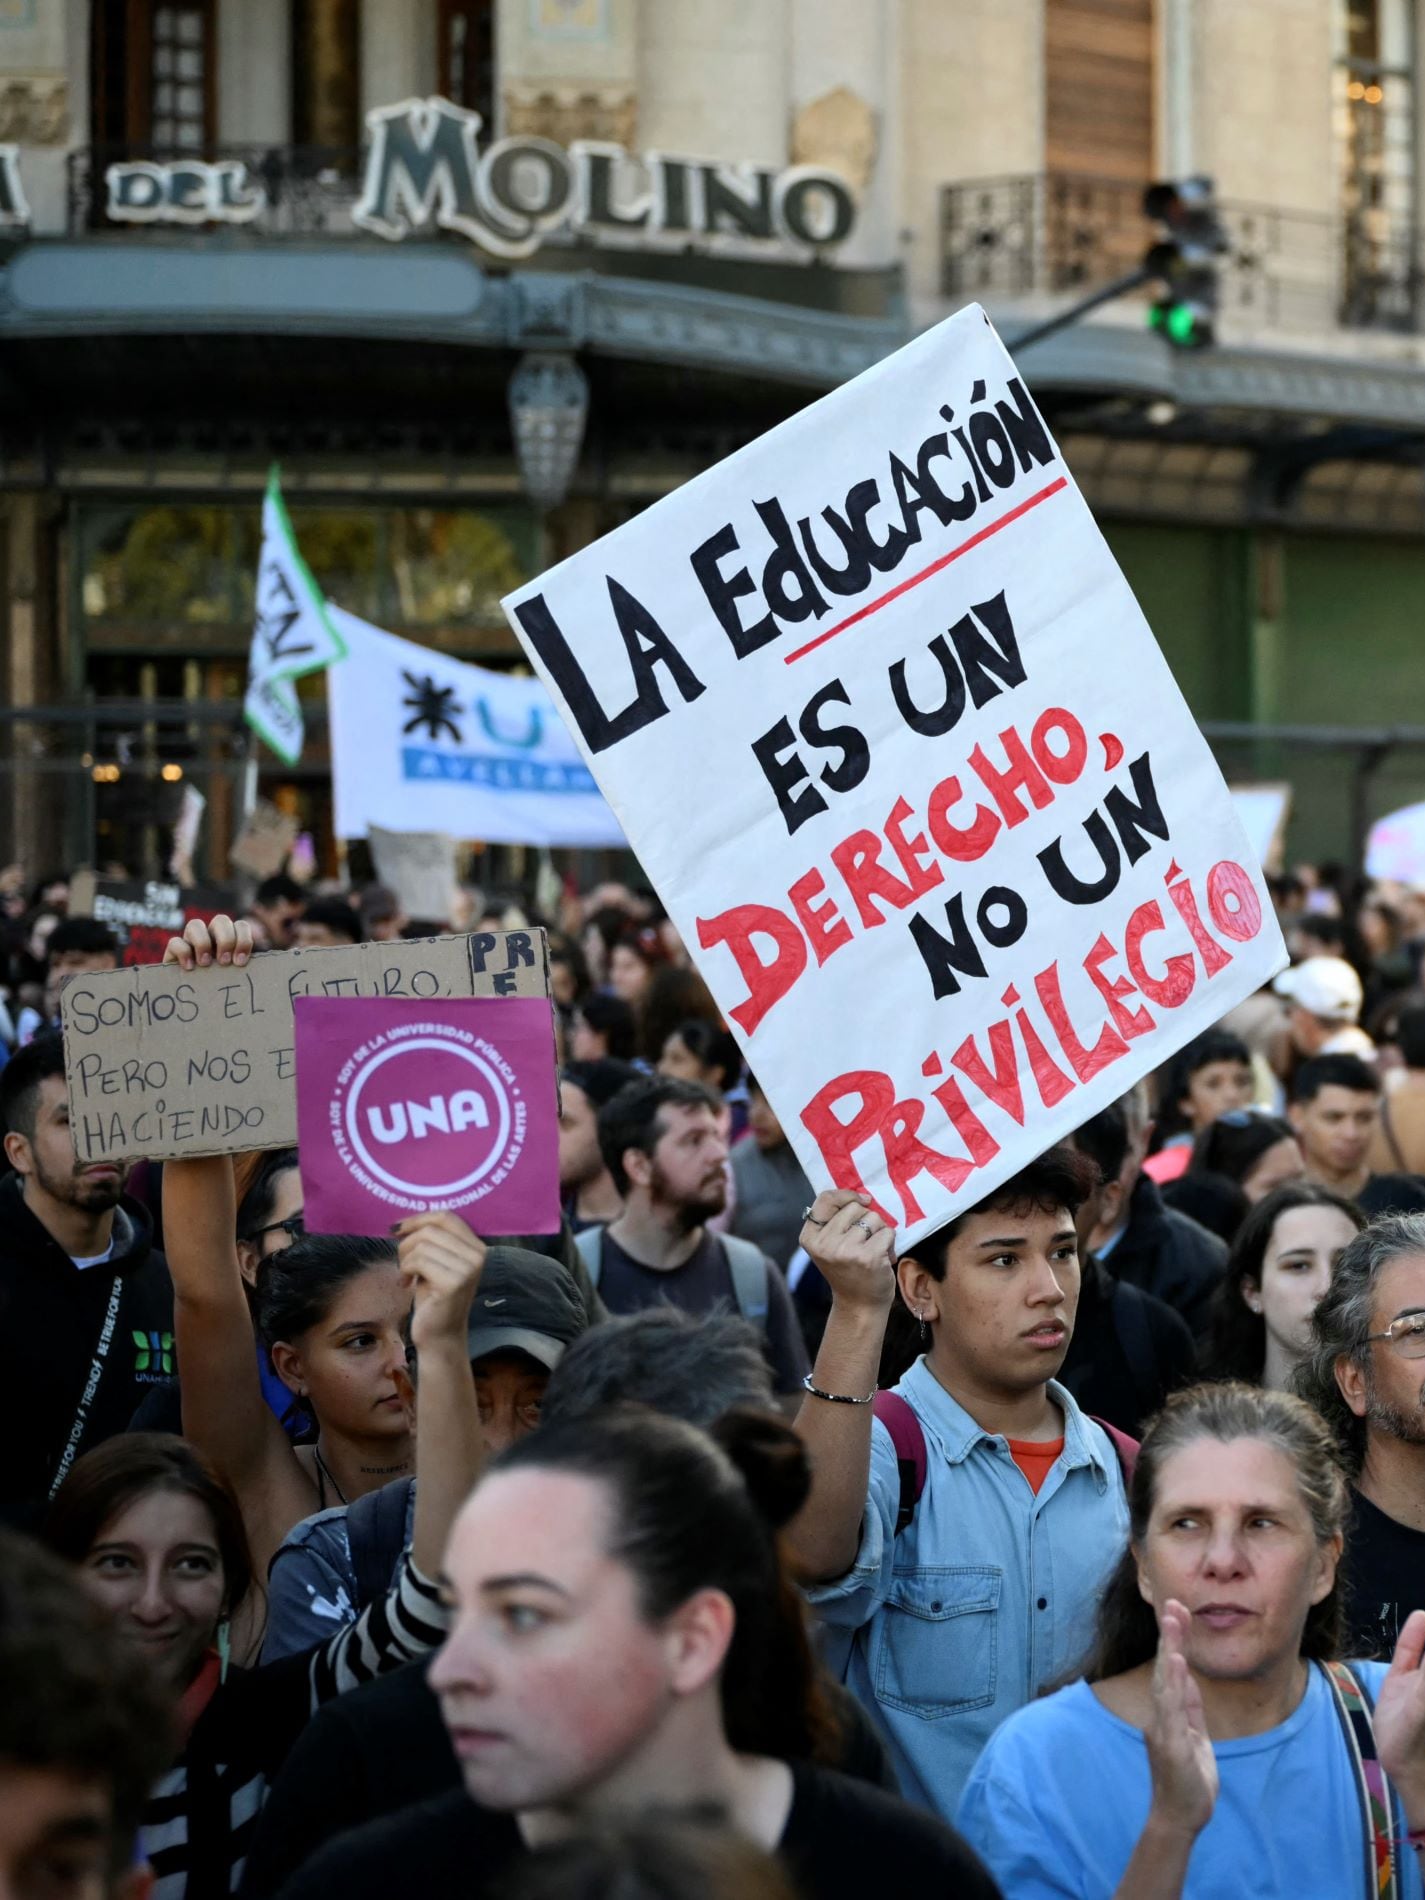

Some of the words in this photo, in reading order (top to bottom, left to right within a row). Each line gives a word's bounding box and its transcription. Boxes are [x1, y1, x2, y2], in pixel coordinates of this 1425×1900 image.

[106, 160, 266, 223] DEL
[353, 96, 860, 258] MOLINO
[514, 574, 707, 755] LA
[751, 678, 870, 836] ES
[888, 590, 1028, 738] UN
[1036, 751, 1170, 905] UN
[695, 706, 1124, 1038] DERECHO,
[71, 984, 198, 1034] SOMOS
[217, 974, 265, 1018] EL
[76, 1053, 168, 1098] PERO
[188, 1050, 252, 1085] NOS
[337, 1059, 357, 1085] SOY
[353, 1045, 370, 1061] DE
[368, 1035, 387, 1051] LA
[386, 1023, 474, 1044] UNIVERSIDAD
[473, 1038, 516, 1085] PÚBLICA
[329, 1100, 341, 1126] SOY
[366, 1089, 490, 1144] UNA
[514, 1100, 527, 1144] ARTES
[331, 1129, 346, 1148] DE
[338, 1147, 354, 1165] LA
[505, 1144, 523, 1169] LAS
[349, 1163, 427, 1212] UNIVERSIDAD
[429, 1184, 494, 1212] NACIONAL
[490, 1168, 507, 1186] DE
[107, 1296, 119, 1319] FOR
[101, 1317, 116, 1343] TRUE
[69, 1419, 84, 1443] YOU
[61, 1442, 77, 1466] FOR
